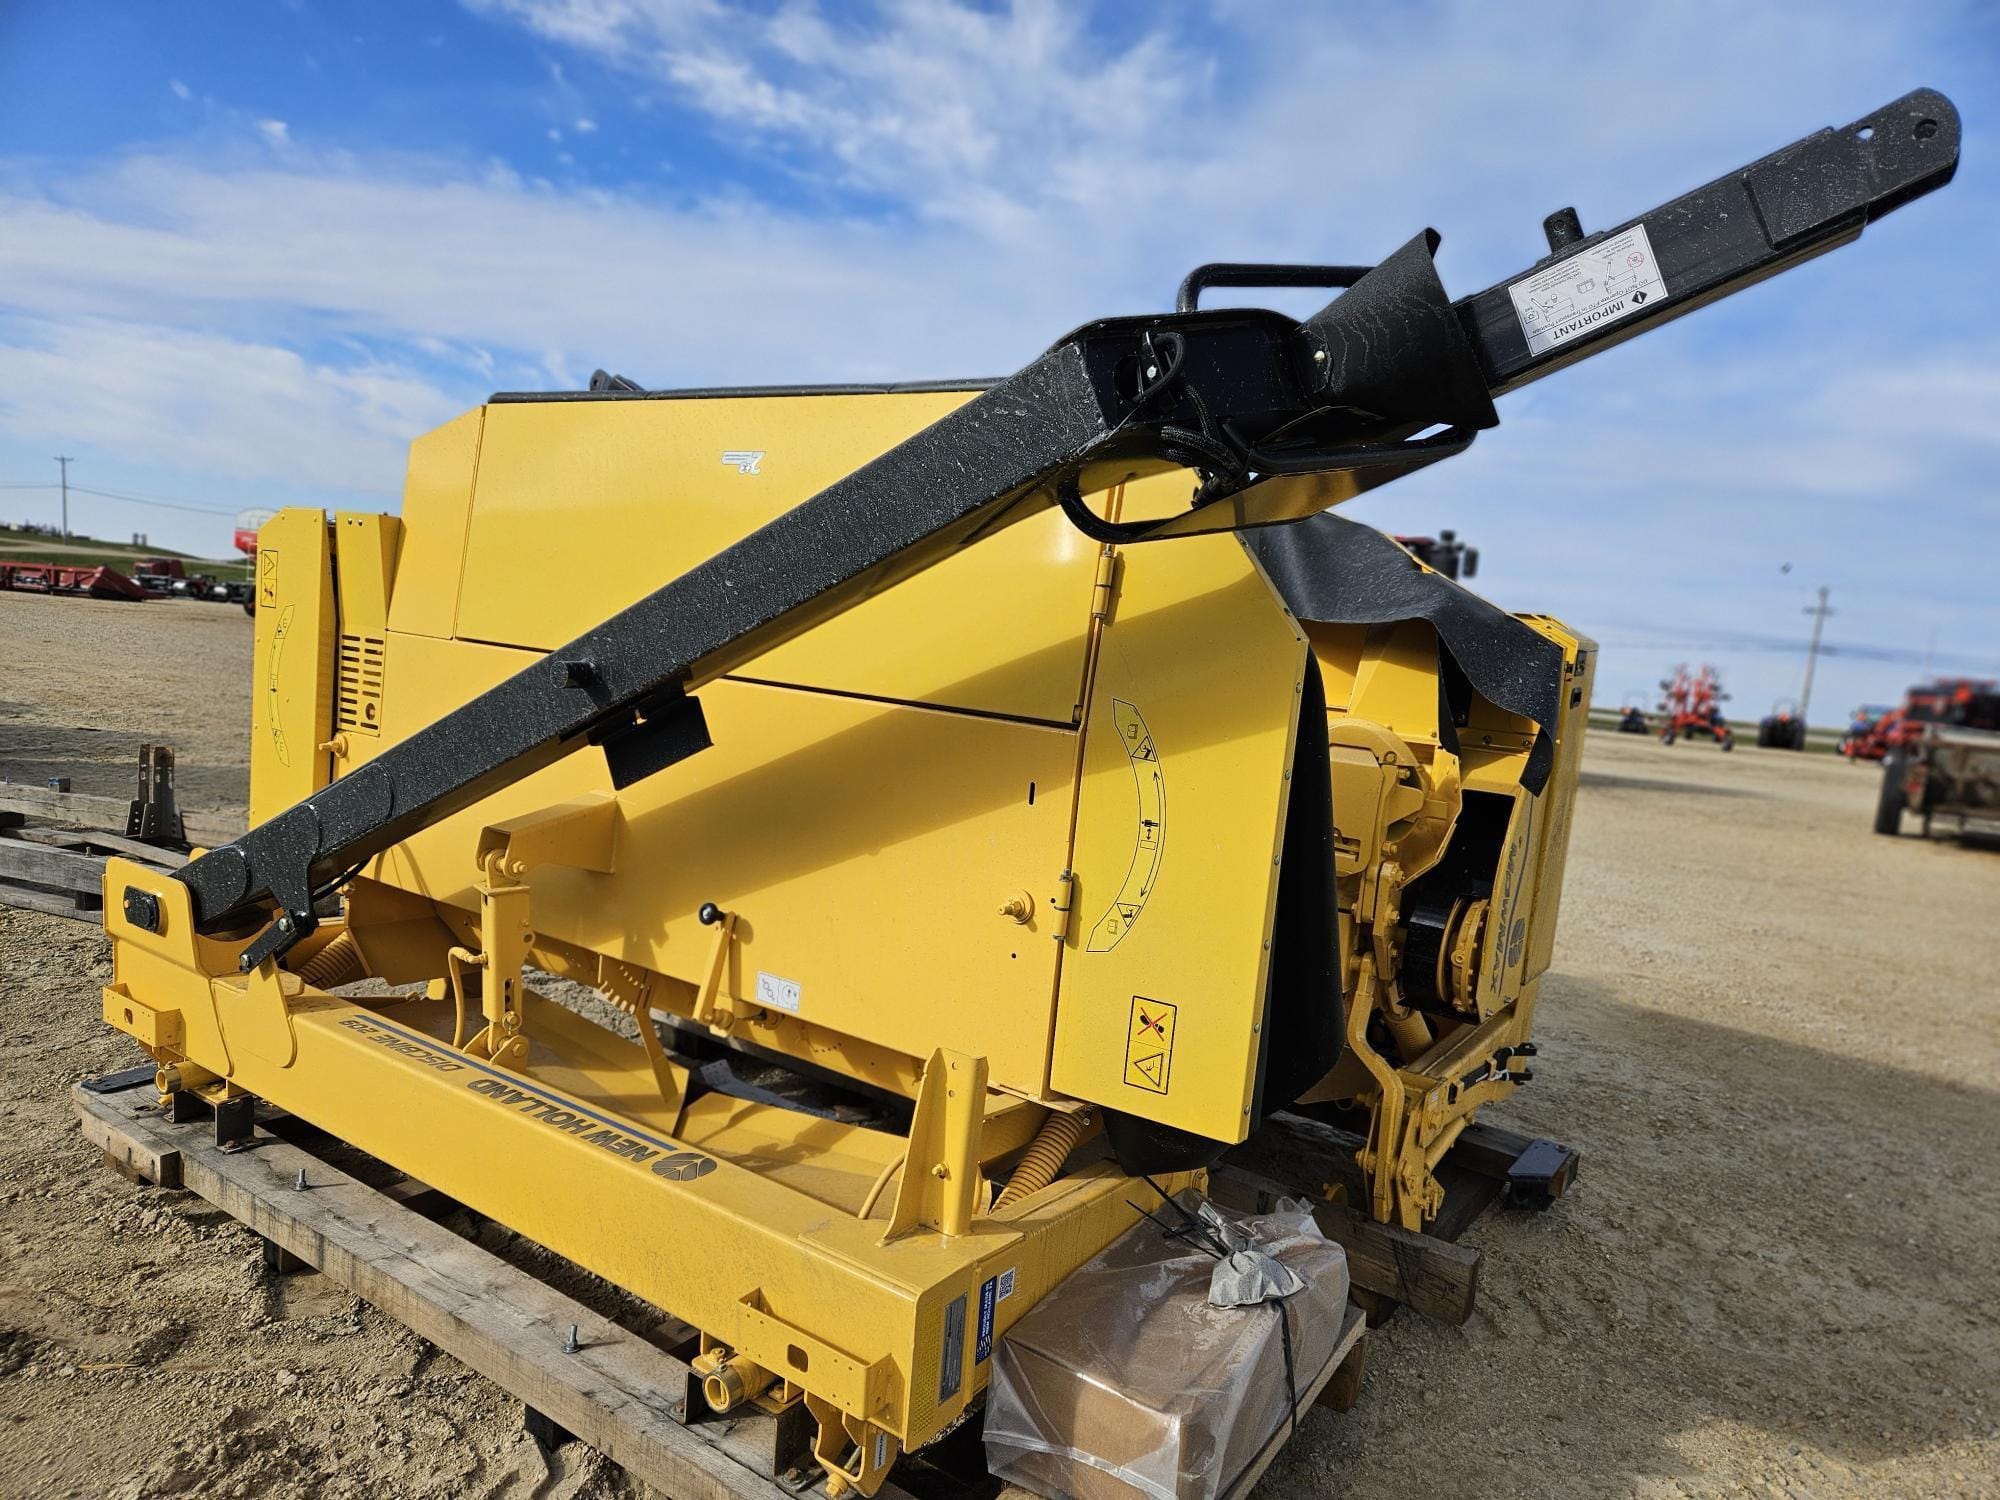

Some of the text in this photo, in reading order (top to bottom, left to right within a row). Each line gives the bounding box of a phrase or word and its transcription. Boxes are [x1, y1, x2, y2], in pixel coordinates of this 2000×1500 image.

[1624, 283, 1637, 292] NOT
[1638, 278, 1648, 286] DO
[1600, 289, 1623, 303] Operate
[1587, 300, 1600, 309] PTO
[1551, 300, 1625, 340] IMPORTANT
[1554, 308, 1580, 324] Transport
[1531, 321, 1554, 334] Position
[1490, 842, 1518, 995] MOWMAX
[338, 1020, 465, 1072] DISCBINE 209
[466, 1079, 659, 1163] NEW HOLLAND
